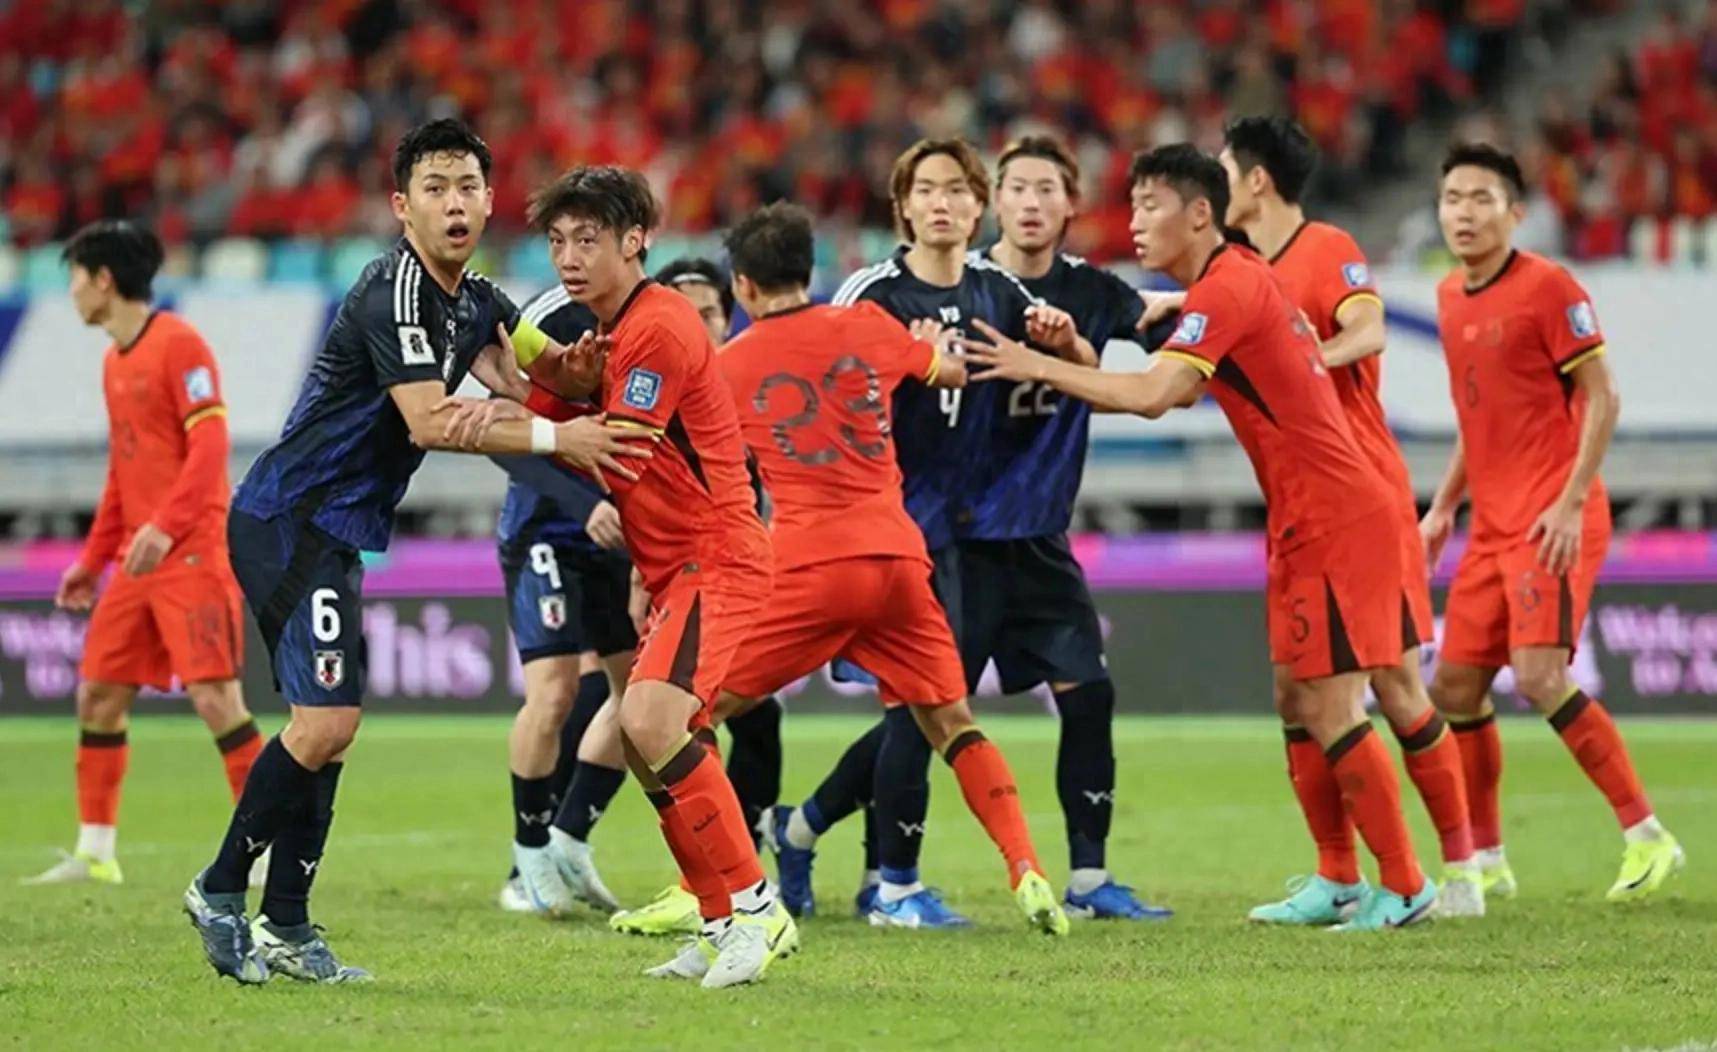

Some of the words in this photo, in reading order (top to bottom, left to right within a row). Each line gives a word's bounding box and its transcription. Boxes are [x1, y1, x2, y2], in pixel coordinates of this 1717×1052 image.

[752, 354, 891, 465] 23
[529, 542, 562, 589] 9
[311, 587, 341, 642] 6
